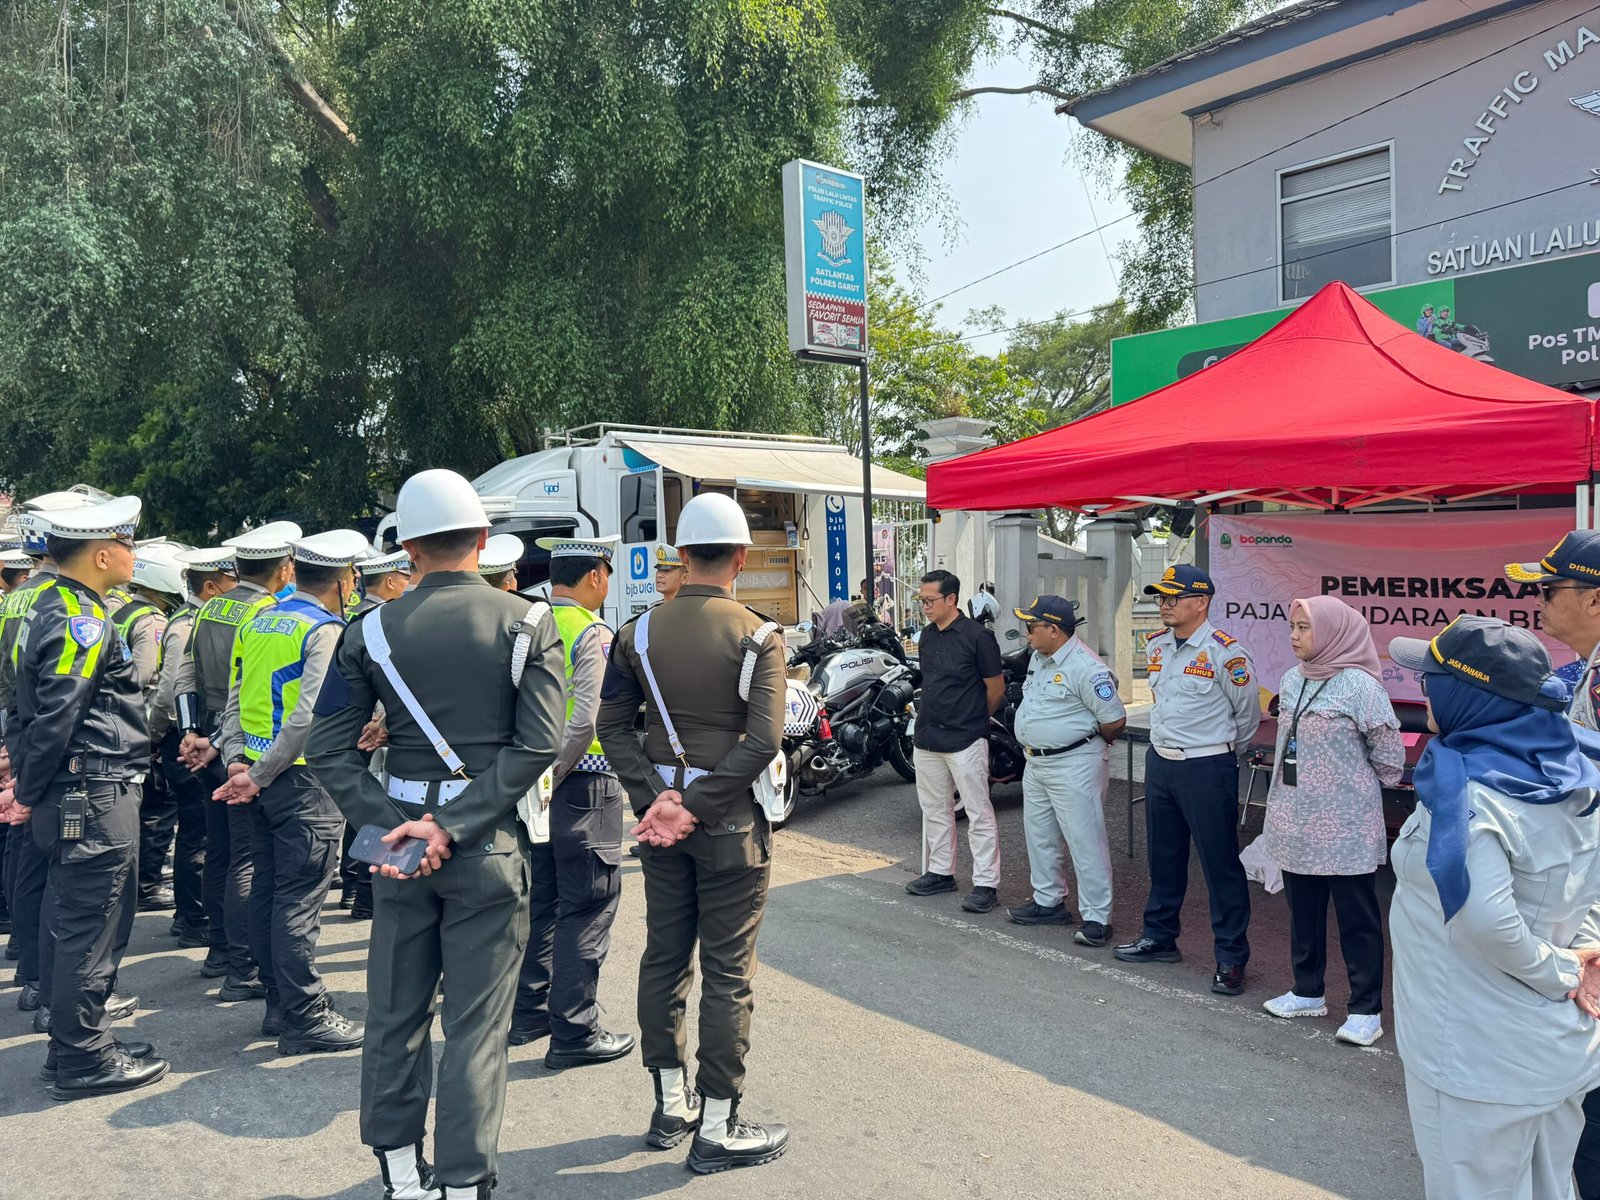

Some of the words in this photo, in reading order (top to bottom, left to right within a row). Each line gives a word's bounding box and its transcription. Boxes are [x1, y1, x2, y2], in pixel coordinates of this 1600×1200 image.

[1437, 70, 1539, 196] TRAFFIC
[807, 185, 824, 196] POLISI
[825, 189, 839, 199] LALU
[839, 193, 858, 203] LINTAS
[813, 194, 835, 205] TRAFFIC
[835, 199, 853, 209] POLICE
[1426, 234, 1522, 275] SATUAN
[1528, 219, 1600, 257] LALU
[815, 267, 855, 282] SATLANTAS
[810, 276, 837, 288] POLRES
[837, 282, 860, 292] GARUT
[807, 300, 846, 313] SEDAAPNYA
[809, 309, 841, 322] FAVORIT
[841, 314, 864, 325] SEMUA
[1528, 333, 1568, 350] Pos
[1561, 344, 1599, 365] Pol
[1239, 534, 1293, 546] bapenda
[626, 583, 638, 597] bjb
[639, 582, 655, 594] DIGI
[1321, 575, 1545, 600] PEMERIKSAA
[201, 599, 250, 624] POLISI
[1225, 602, 1291, 621] PAJA
[252, 616, 299, 636] POLISI
[839, 656, 874, 671] POLISI
[1185, 667, 1213, 677] DISHUB
[1446, 658, 1462, 670] JASA
[1461, 664, 1490, 683] RAHARJA
